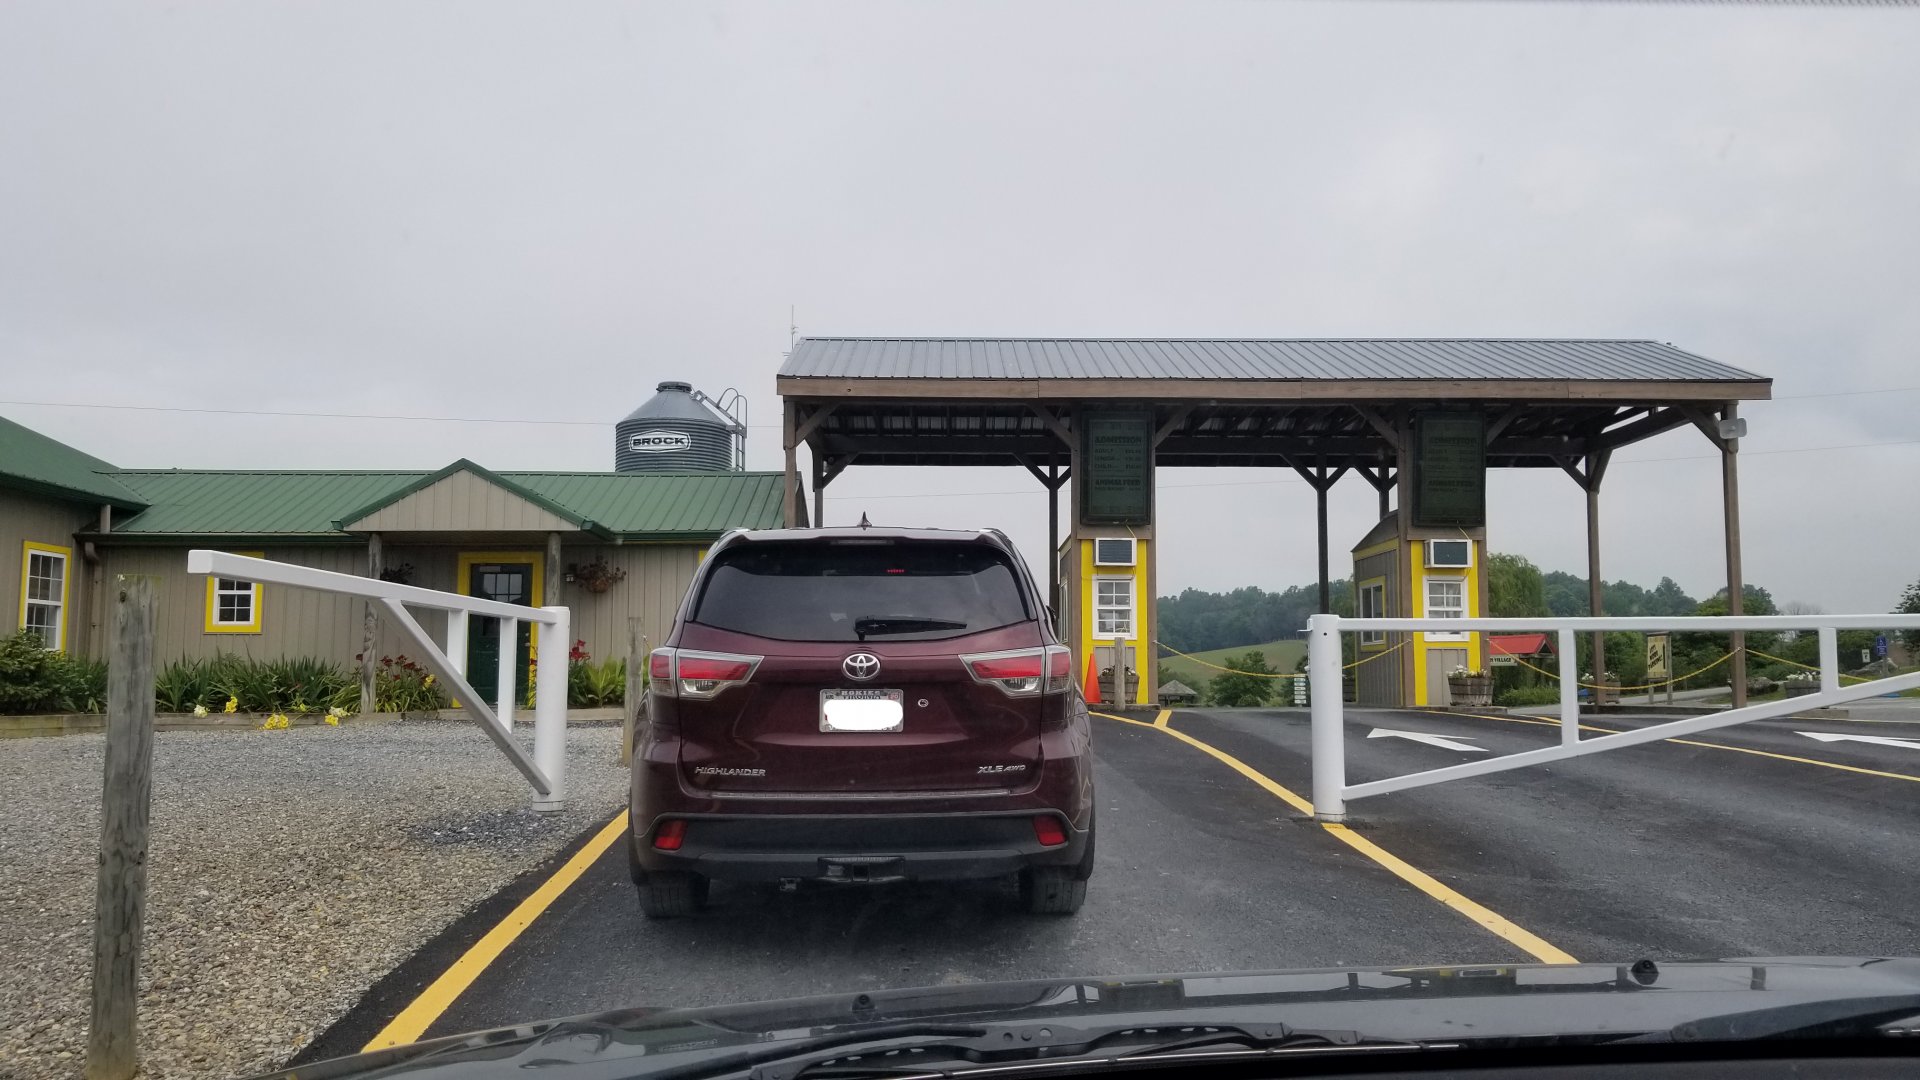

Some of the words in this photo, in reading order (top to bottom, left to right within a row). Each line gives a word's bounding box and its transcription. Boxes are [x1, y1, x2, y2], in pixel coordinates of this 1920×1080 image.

[633, 437, 687, 446] BROCK
[695, 766, 766, 777] HIGHLANDER
[977, 765, 1003, 774] XLE
[1003, 764, 1026, 772] AWD
